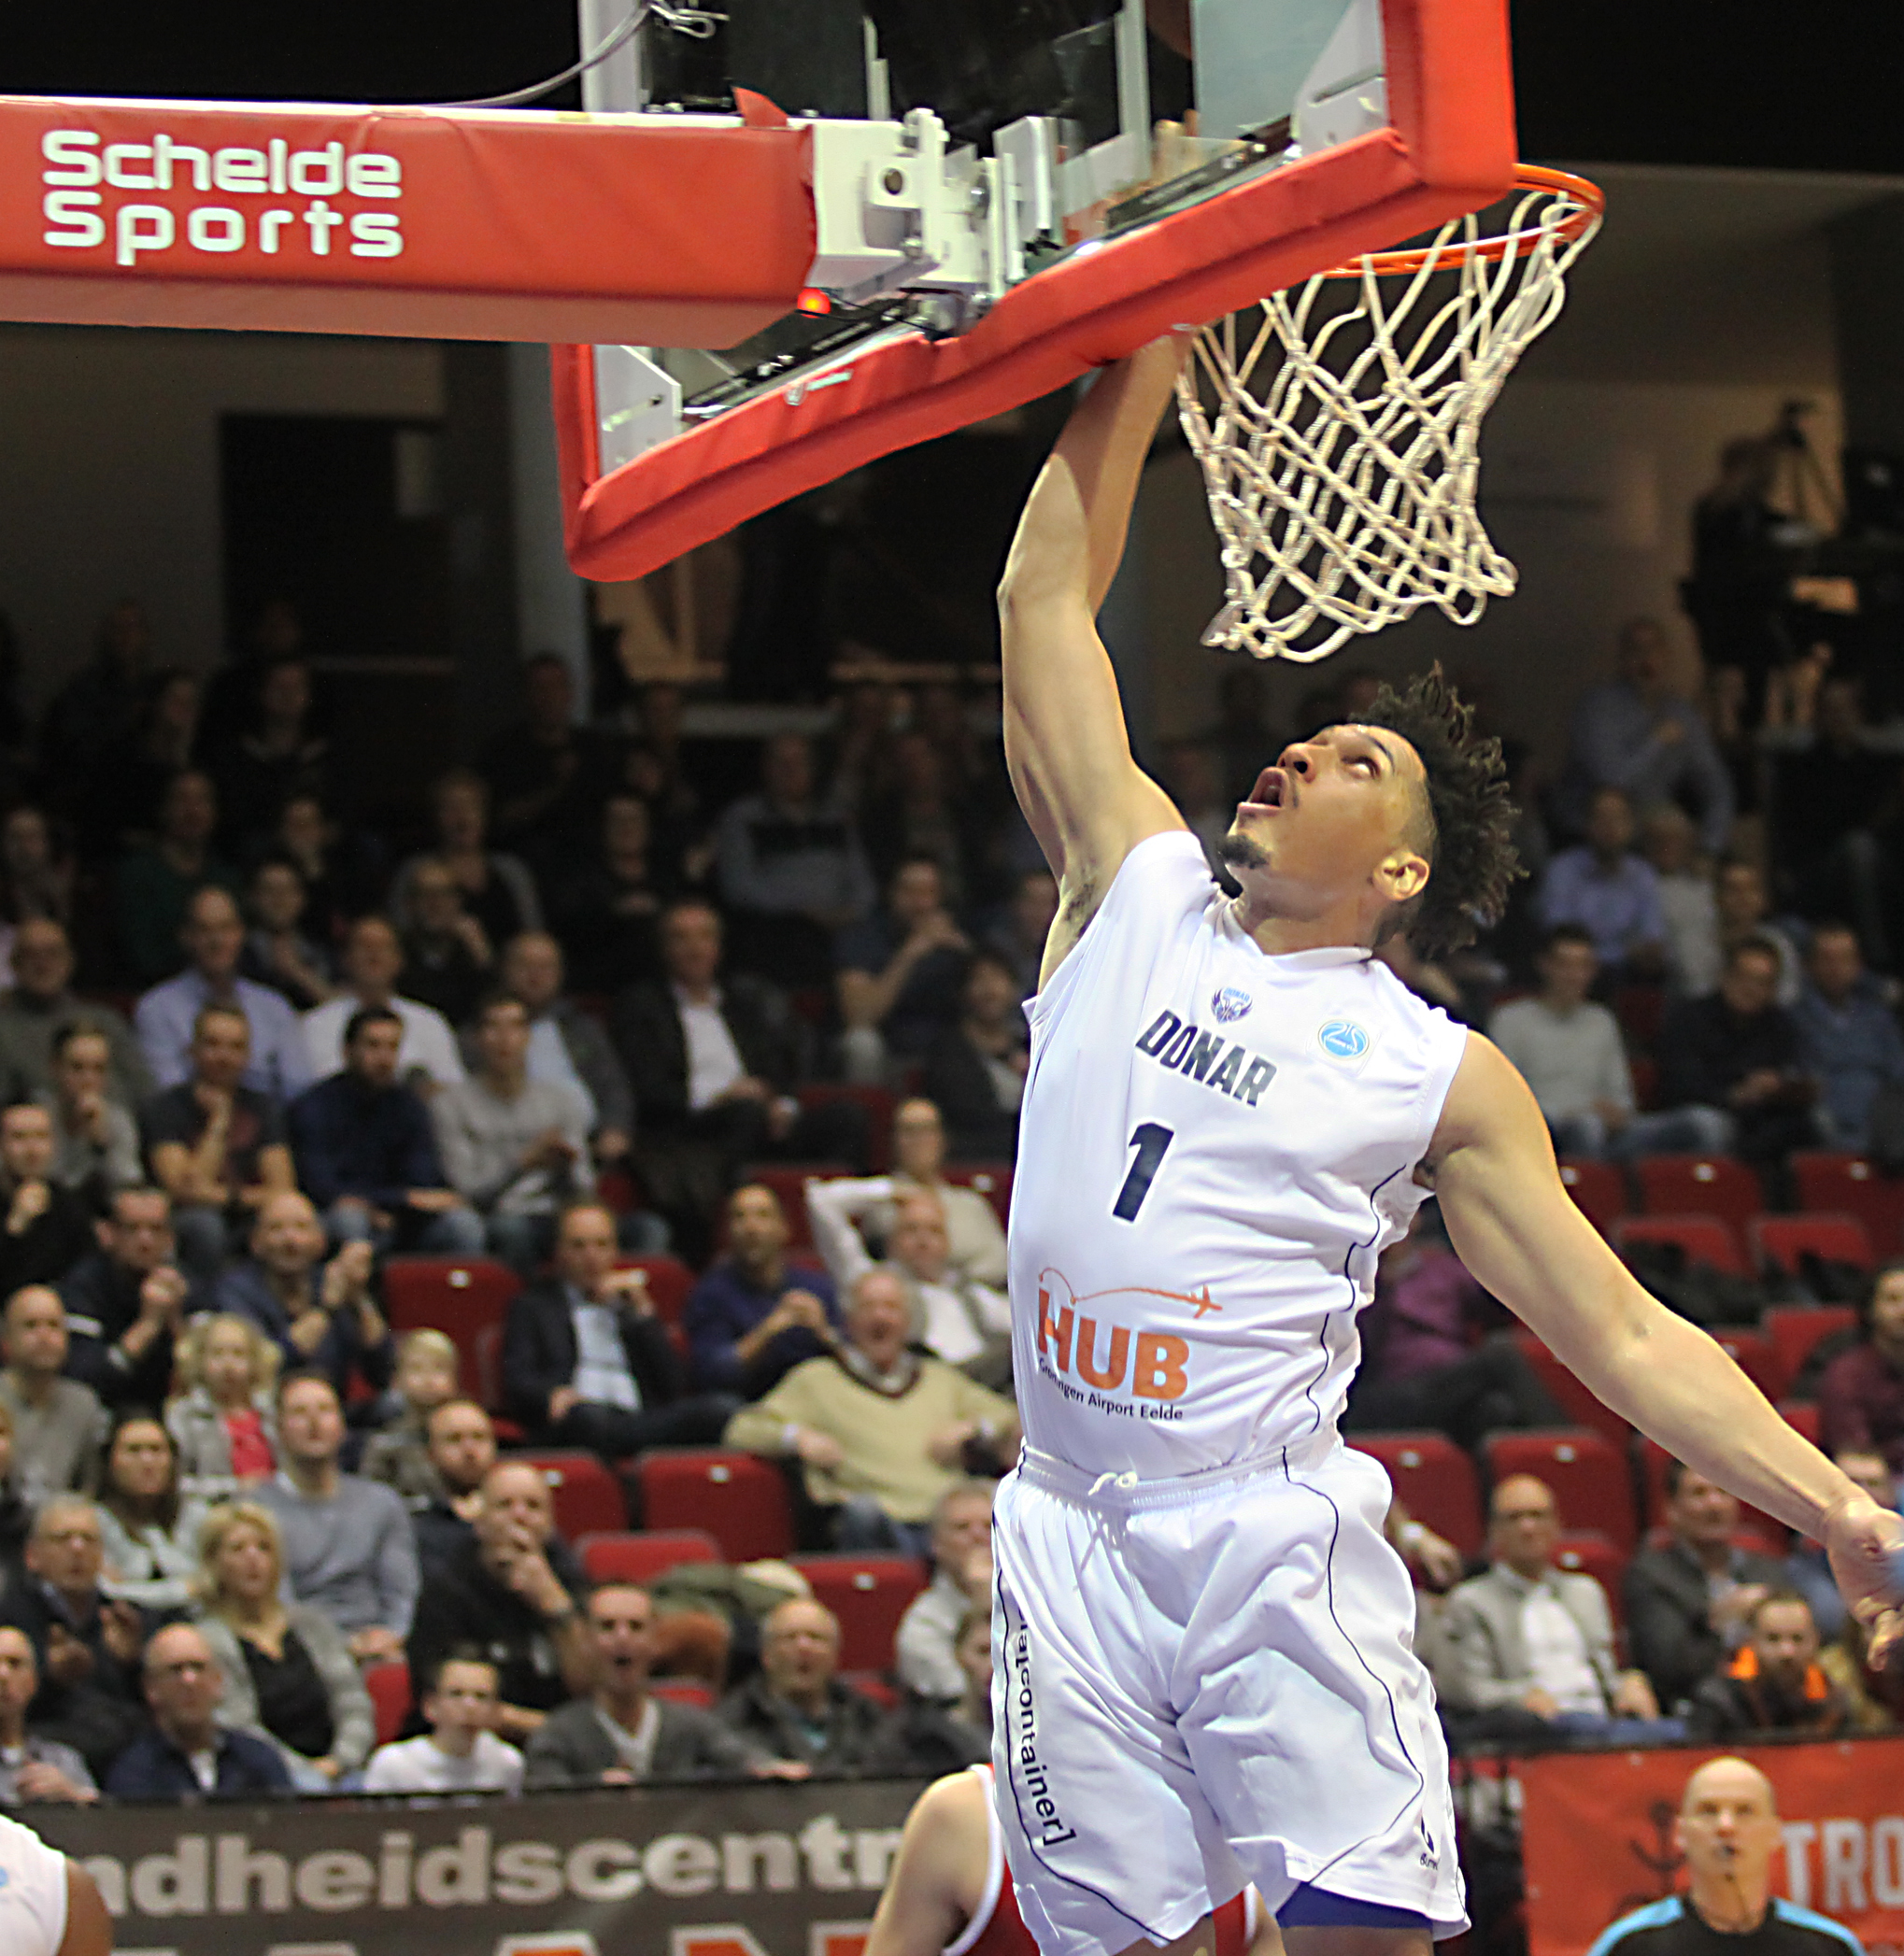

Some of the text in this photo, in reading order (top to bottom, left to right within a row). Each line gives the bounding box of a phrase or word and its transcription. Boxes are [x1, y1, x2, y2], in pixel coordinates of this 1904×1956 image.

[42, 129, 402, 199] Schelde
[43, 190, 404, 266] Sports
[1135, 1008, 1278, 1108] DONAR
[1112, 1122, 1175, 1223] 1
[1038, 1288, 1190, 1400] HUB
[1087, 1393, 1134, 1416] Airport
[1140, 1404, 1184, 1421] Eelde
